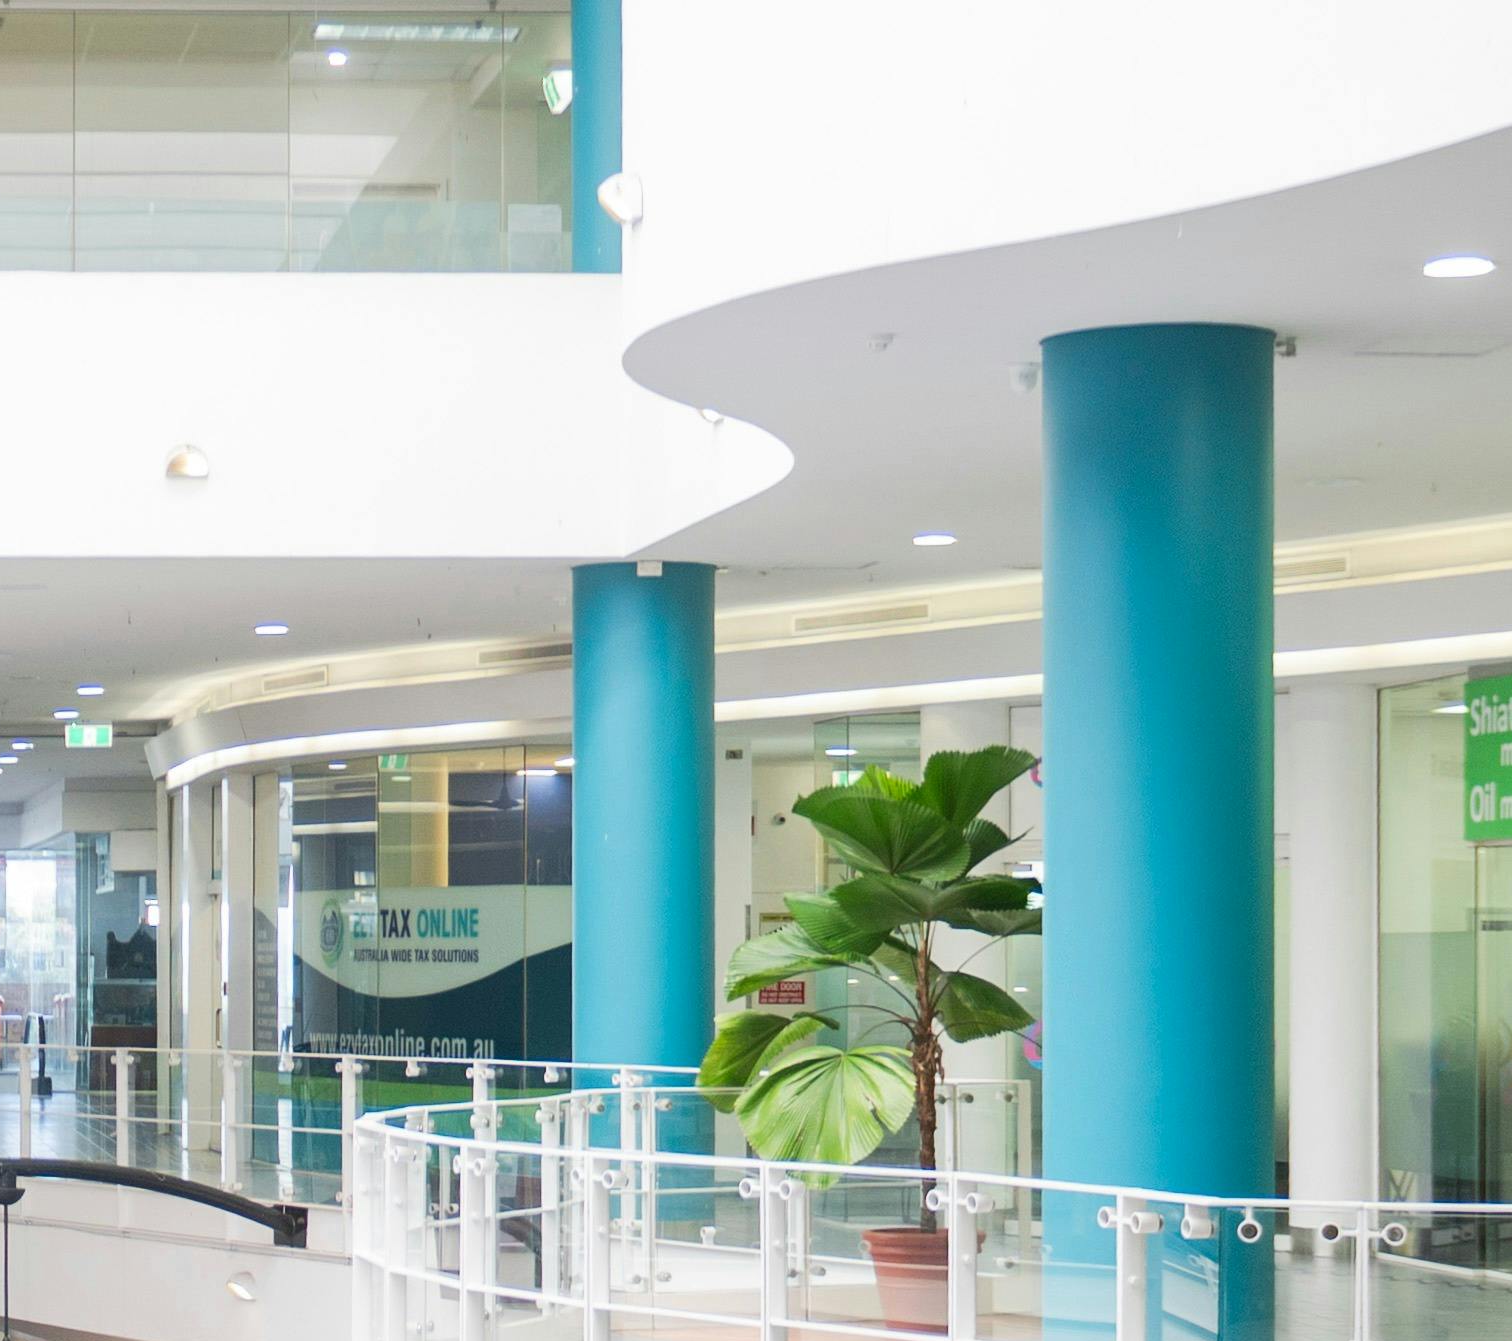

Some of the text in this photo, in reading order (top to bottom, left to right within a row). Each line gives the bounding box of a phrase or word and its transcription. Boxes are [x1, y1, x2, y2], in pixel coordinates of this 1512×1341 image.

[1470, 781, 1497, 823] Oil
[380, 908, 411, 939] TAX
[416, 908, 480, 939] ONLINE
[353, 948, 480, 963] AUSTRALIA WIDE TAX SOLUTIONS
[309, 1029, 495, 1059] www.ezytaxonline.com.au
